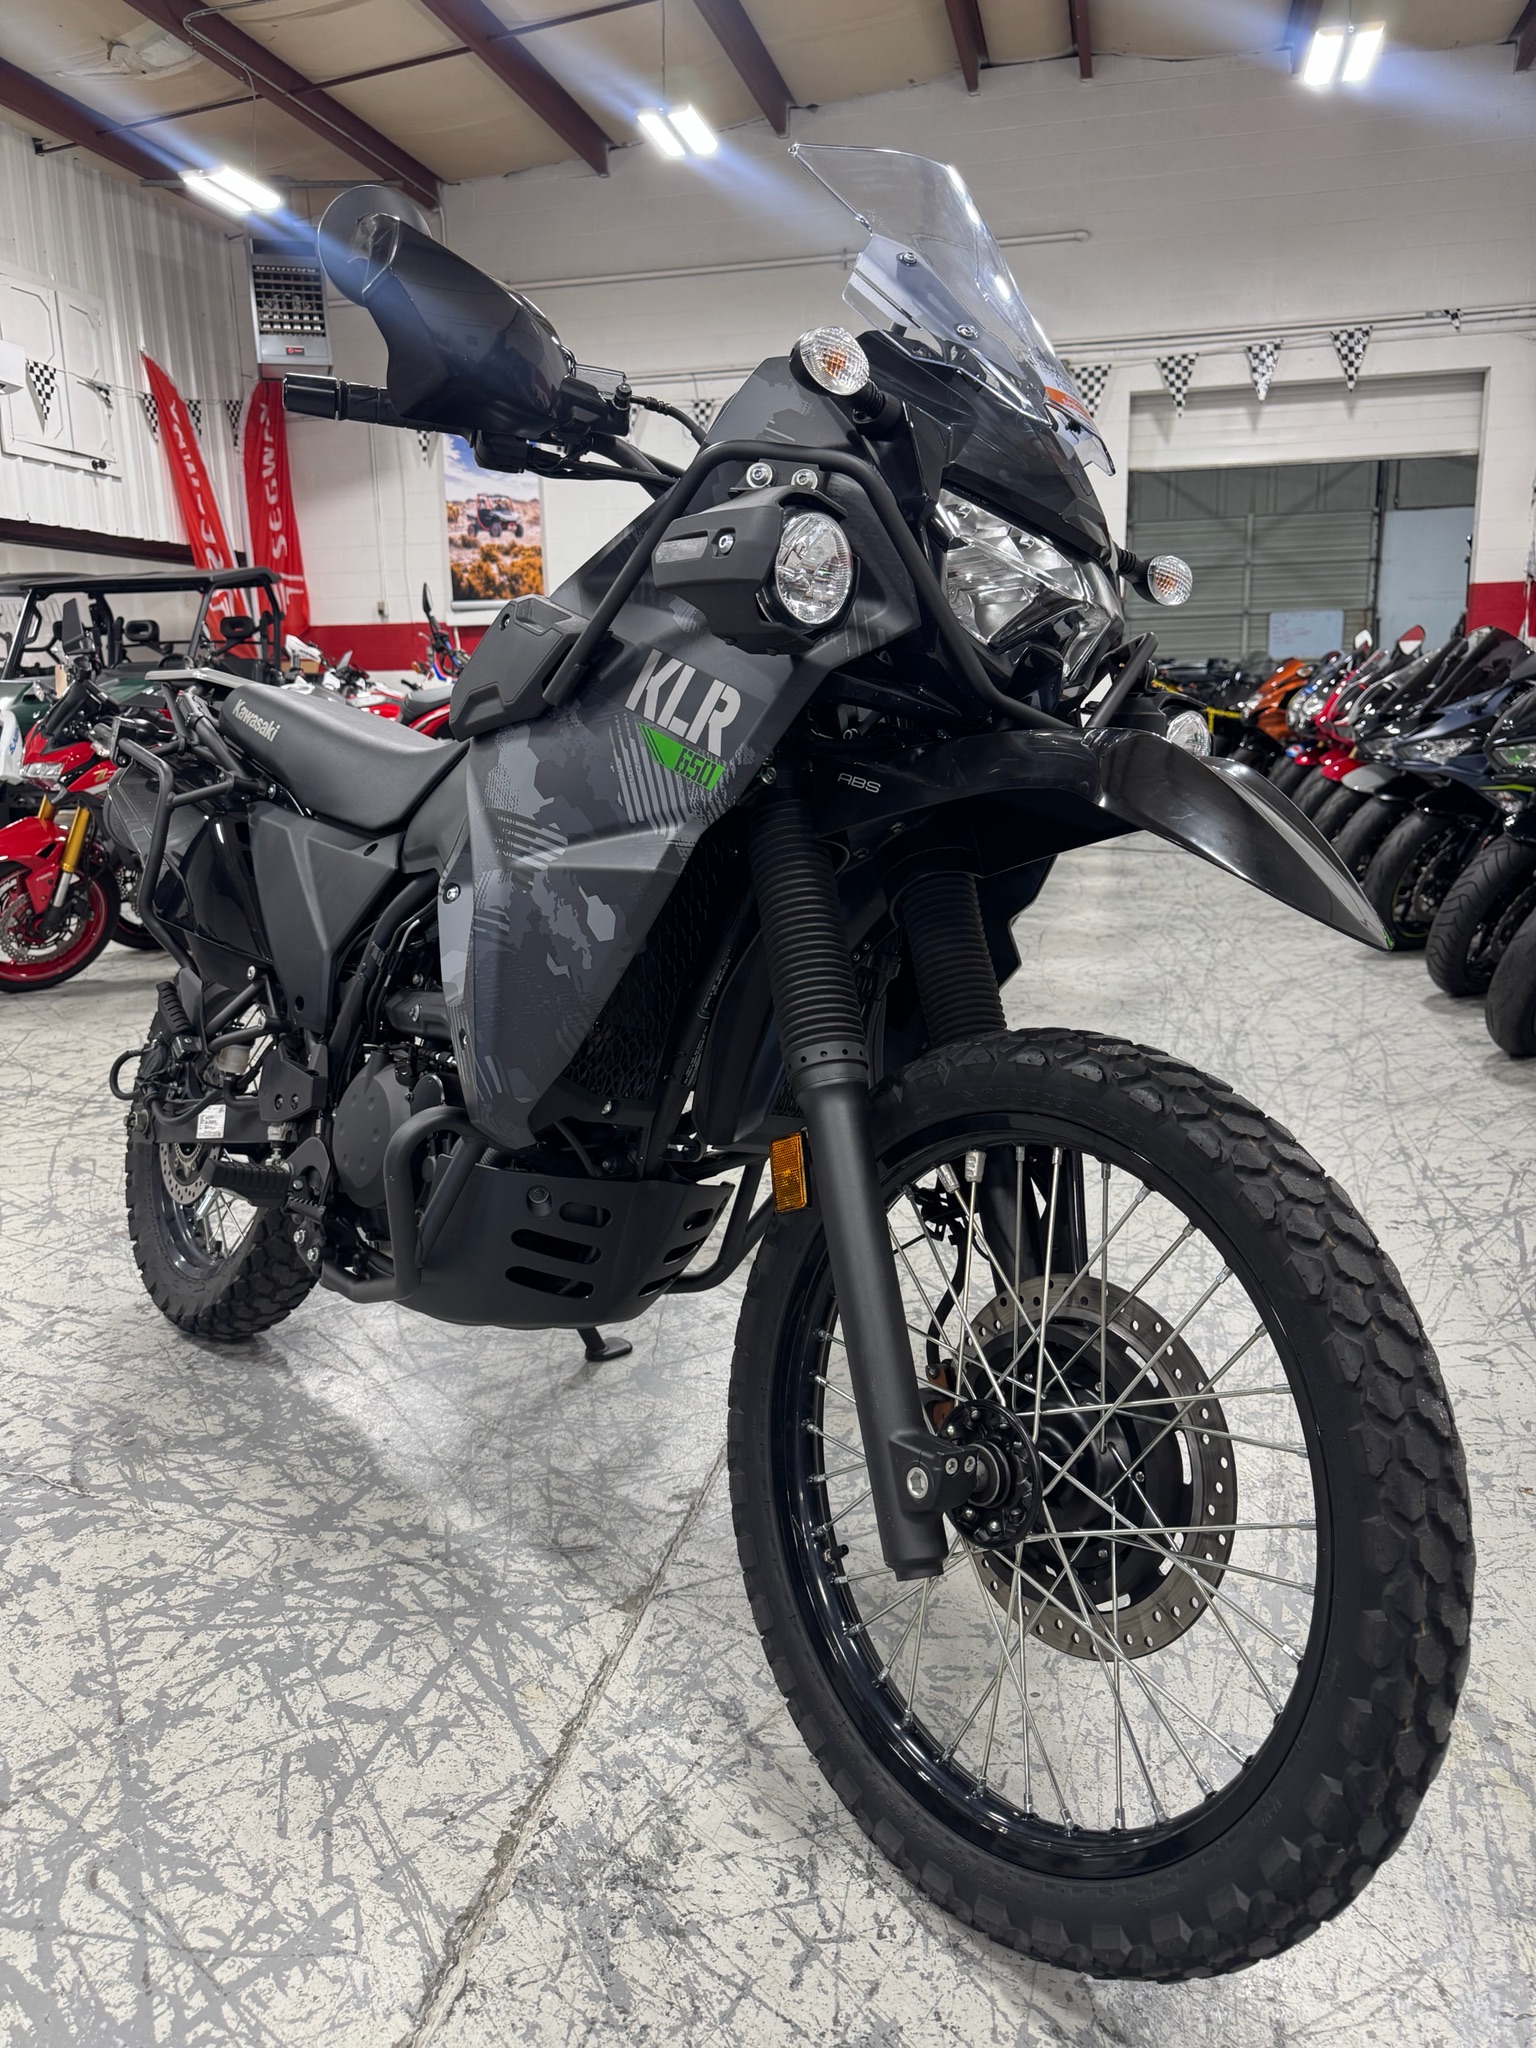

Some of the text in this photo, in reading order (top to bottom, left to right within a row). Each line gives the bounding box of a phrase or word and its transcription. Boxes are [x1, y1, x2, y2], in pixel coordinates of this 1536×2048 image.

[232, 699, 281, 742] Kawasaki
[624, 648, 742, 757] KLR
[674, 747, 718, 788] 650
[837, 772, 881, 793] ABS
